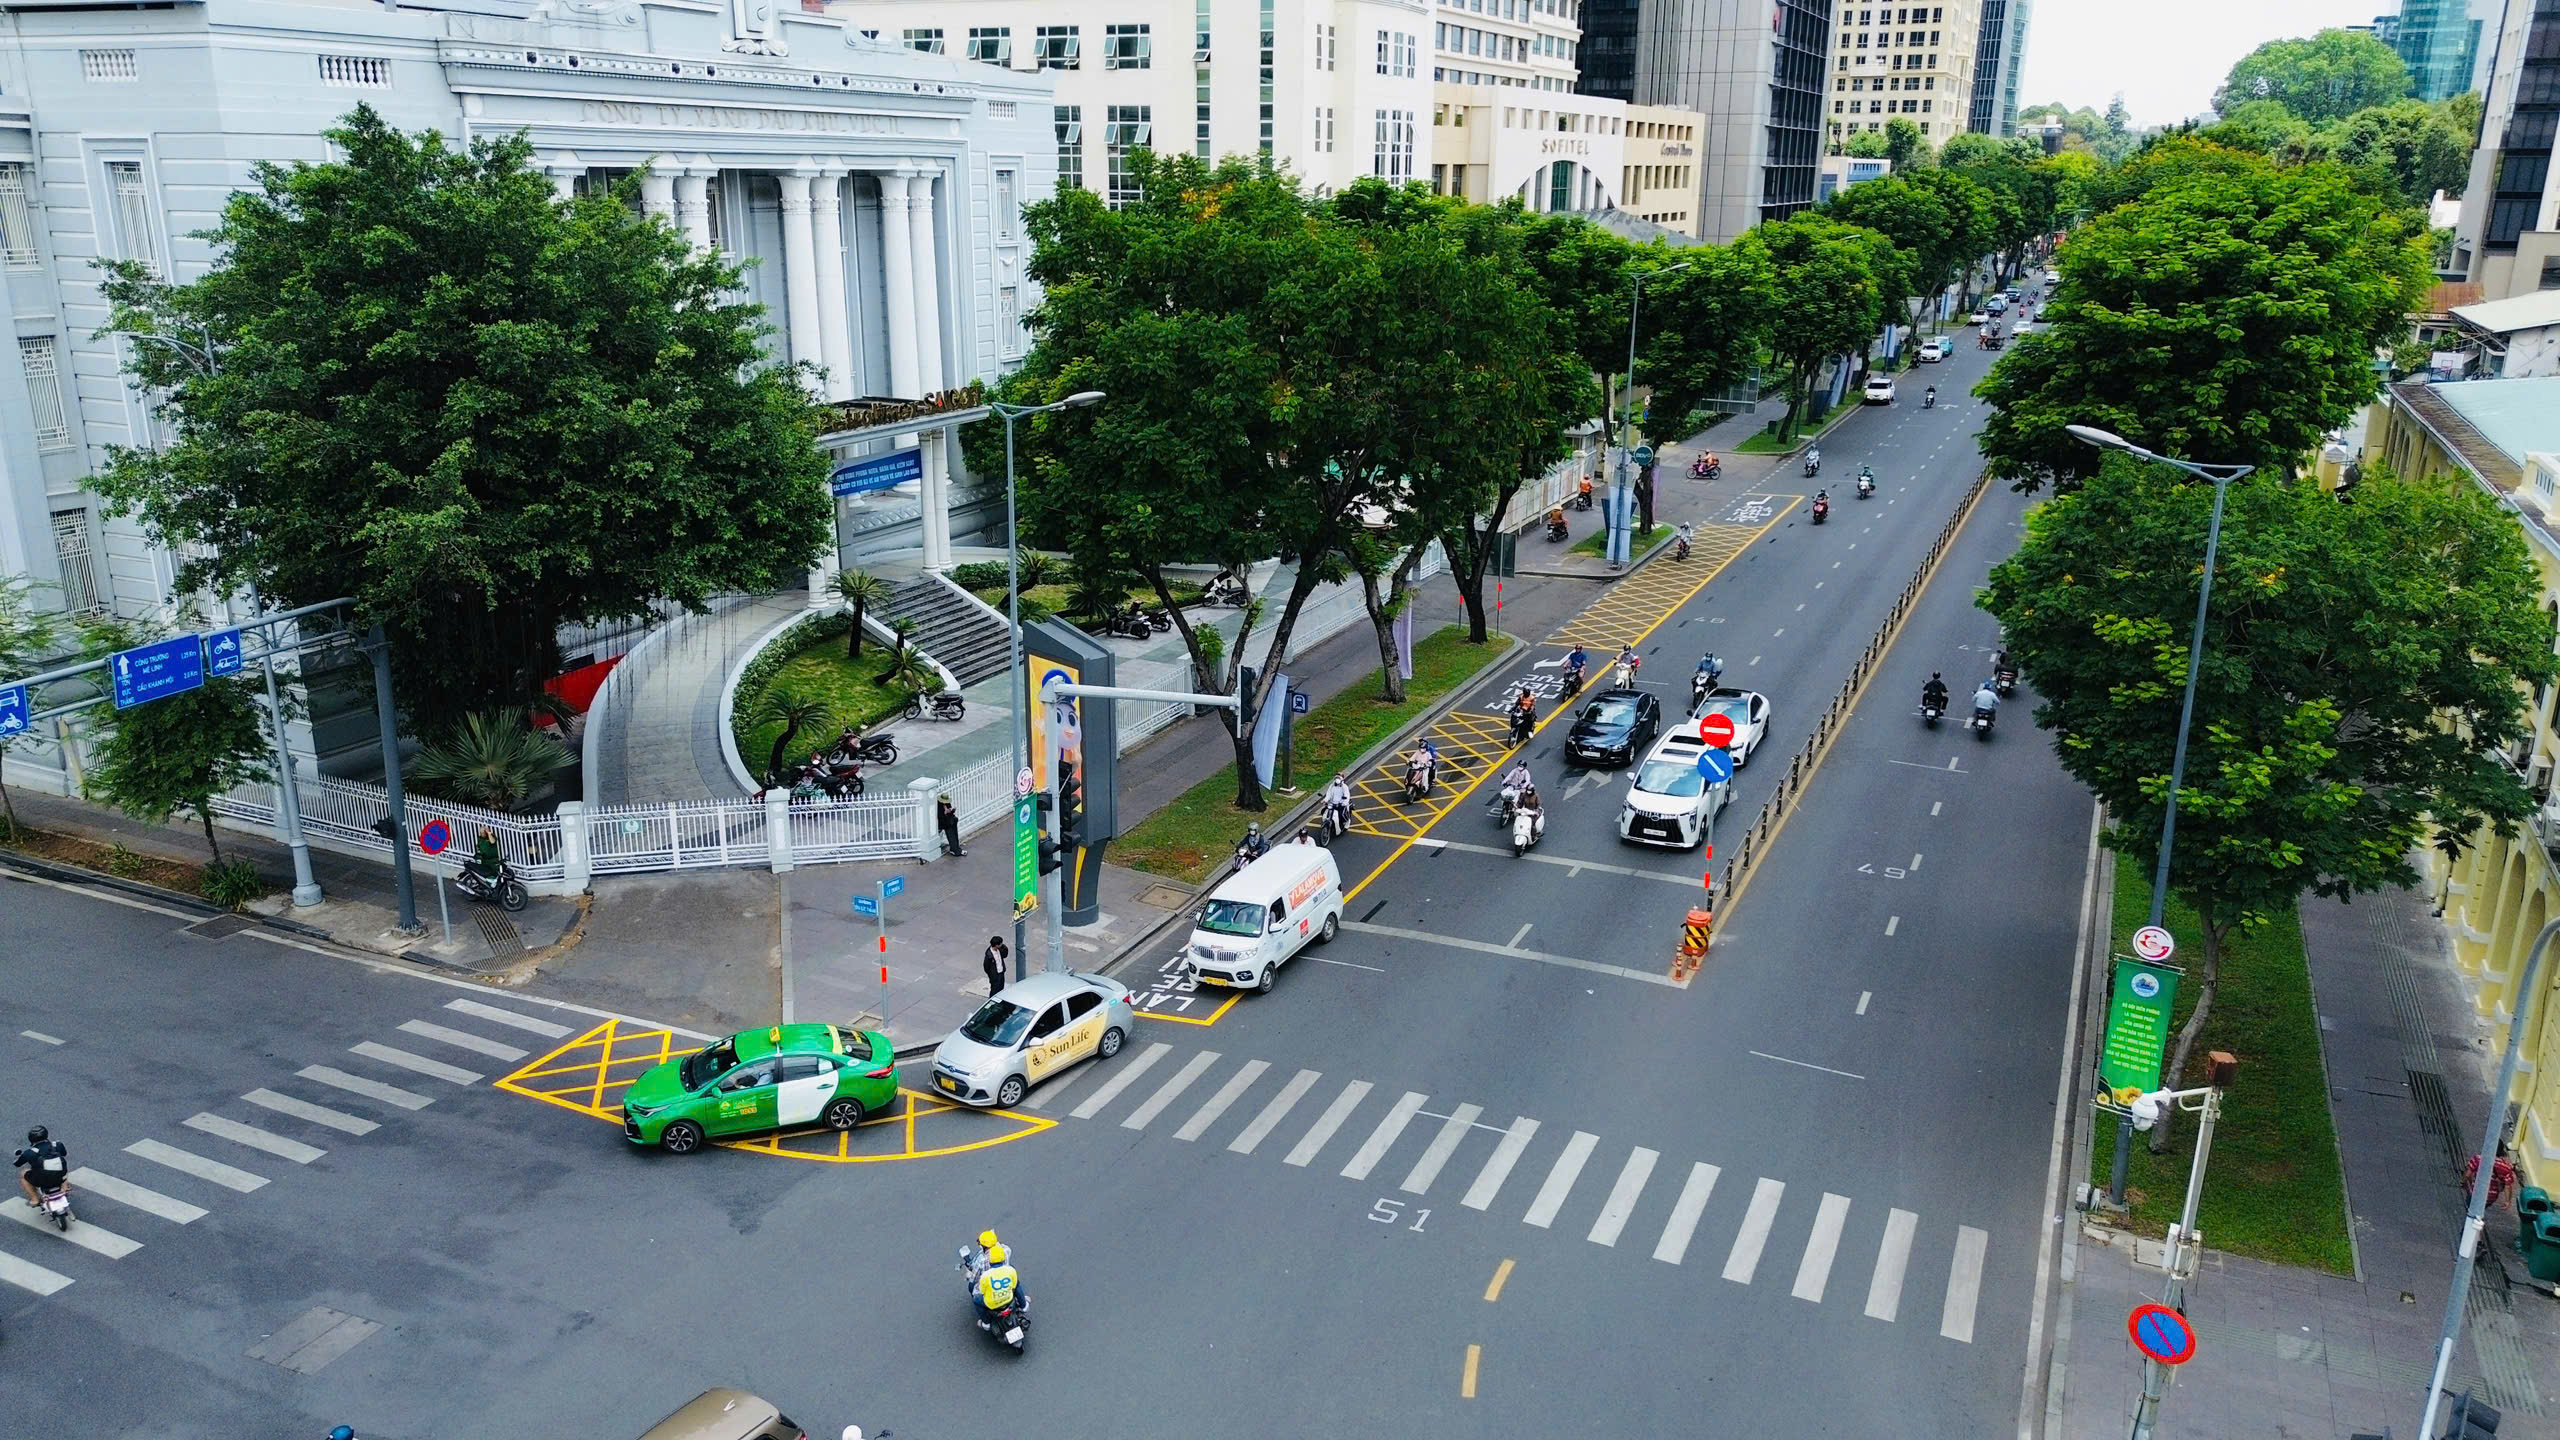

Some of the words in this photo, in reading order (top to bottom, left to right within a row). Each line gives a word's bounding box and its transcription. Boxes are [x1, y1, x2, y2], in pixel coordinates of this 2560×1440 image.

[656, 105, 680, 125] TY
[1542, 139, 1590, 155] SOFITEL
[134, 657, 149, 667] CÔNG
[151, 663, 163, 673] LINH
[1857, 863, 1906, 879] 49
[1049, 1041, 1070, 1058] Sun
[1070, 1029, 1091, 1048] Life
[1367, 1197, 1432, 1233] 51
[990, 1276, 1011, 1291] be
